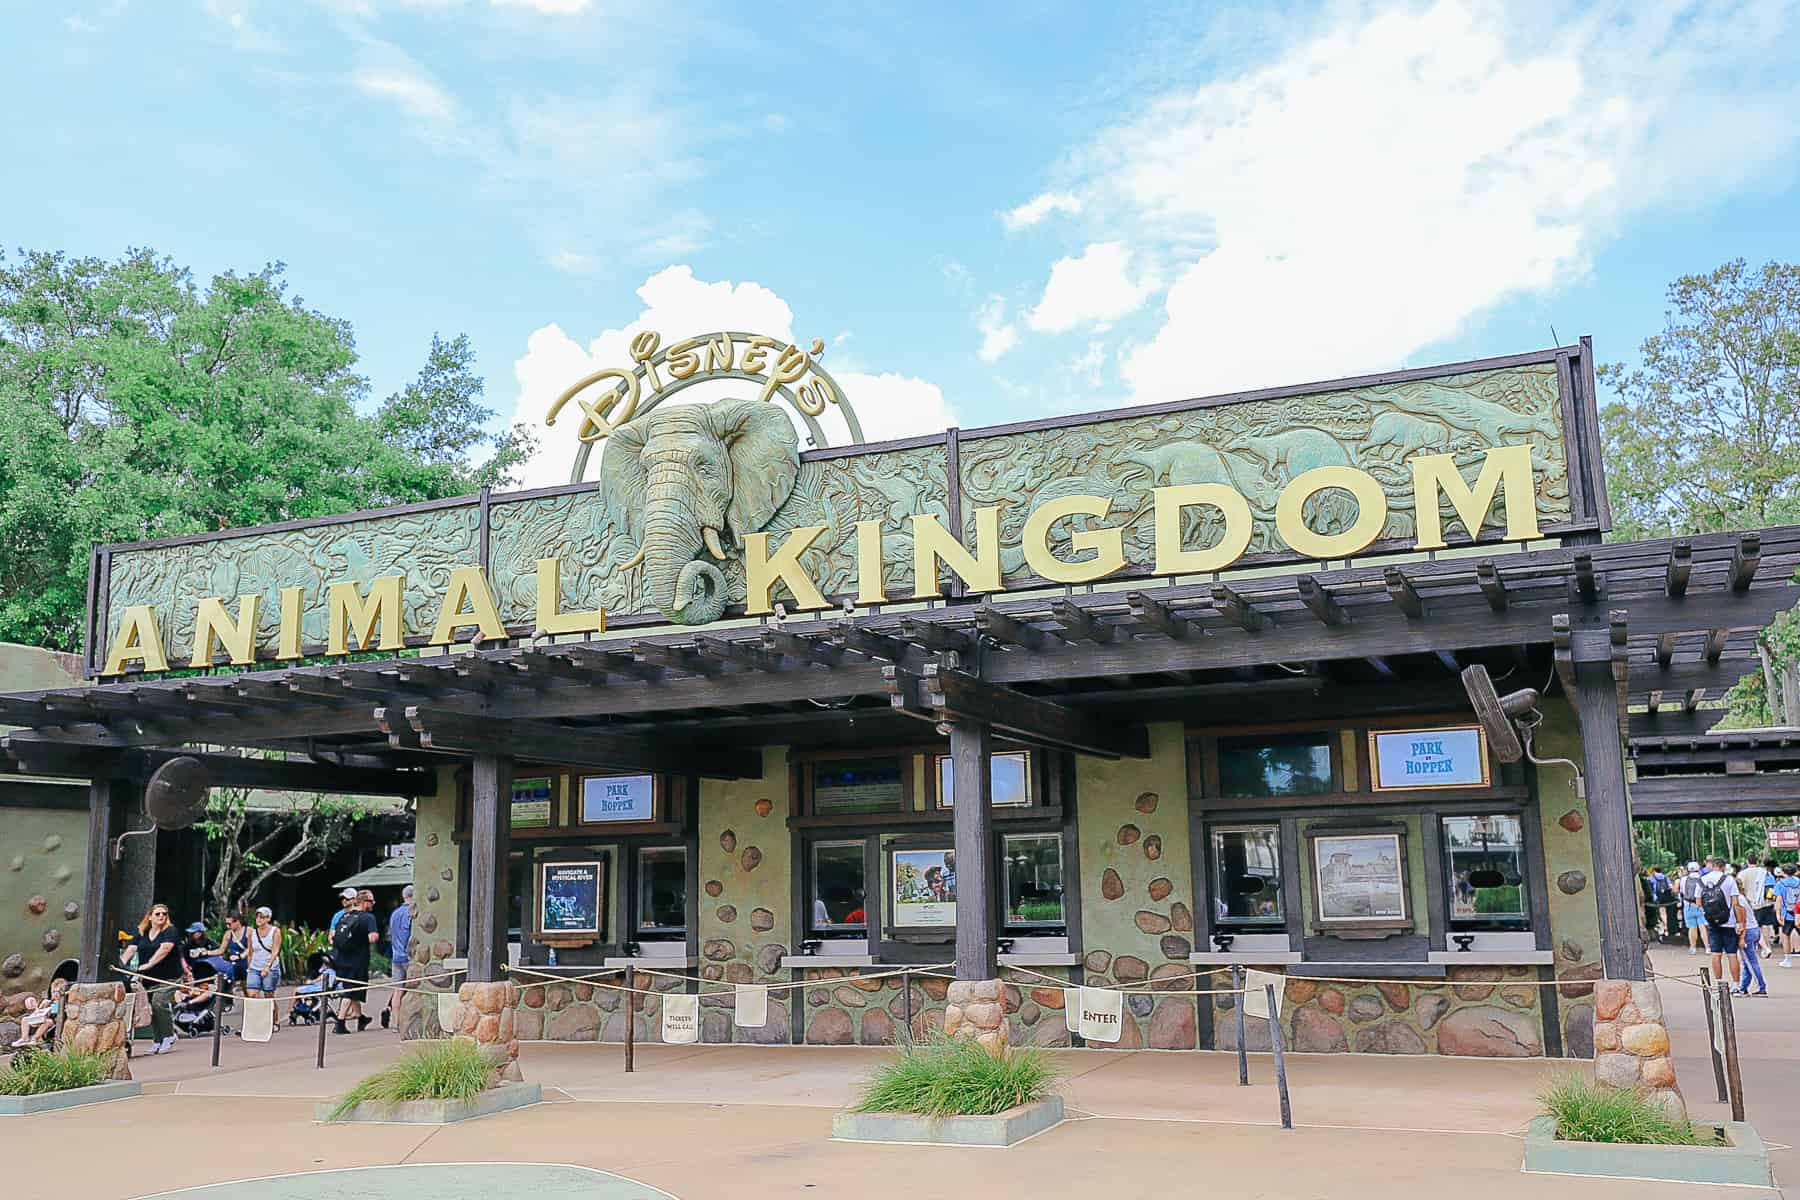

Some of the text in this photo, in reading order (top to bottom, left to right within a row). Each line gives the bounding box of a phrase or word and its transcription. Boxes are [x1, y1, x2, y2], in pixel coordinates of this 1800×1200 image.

[101, 443, 1544, 676] ANIMAL KINGDOM
[1410, 741, 1444, 756] PARK
[1405, 759, 1454, 775] HOPPER
[606, 784, 629, 797] PARK
[601, 799, 634, 812] HOPPER
[1083, 1010, 1118, 1024] ENTER
